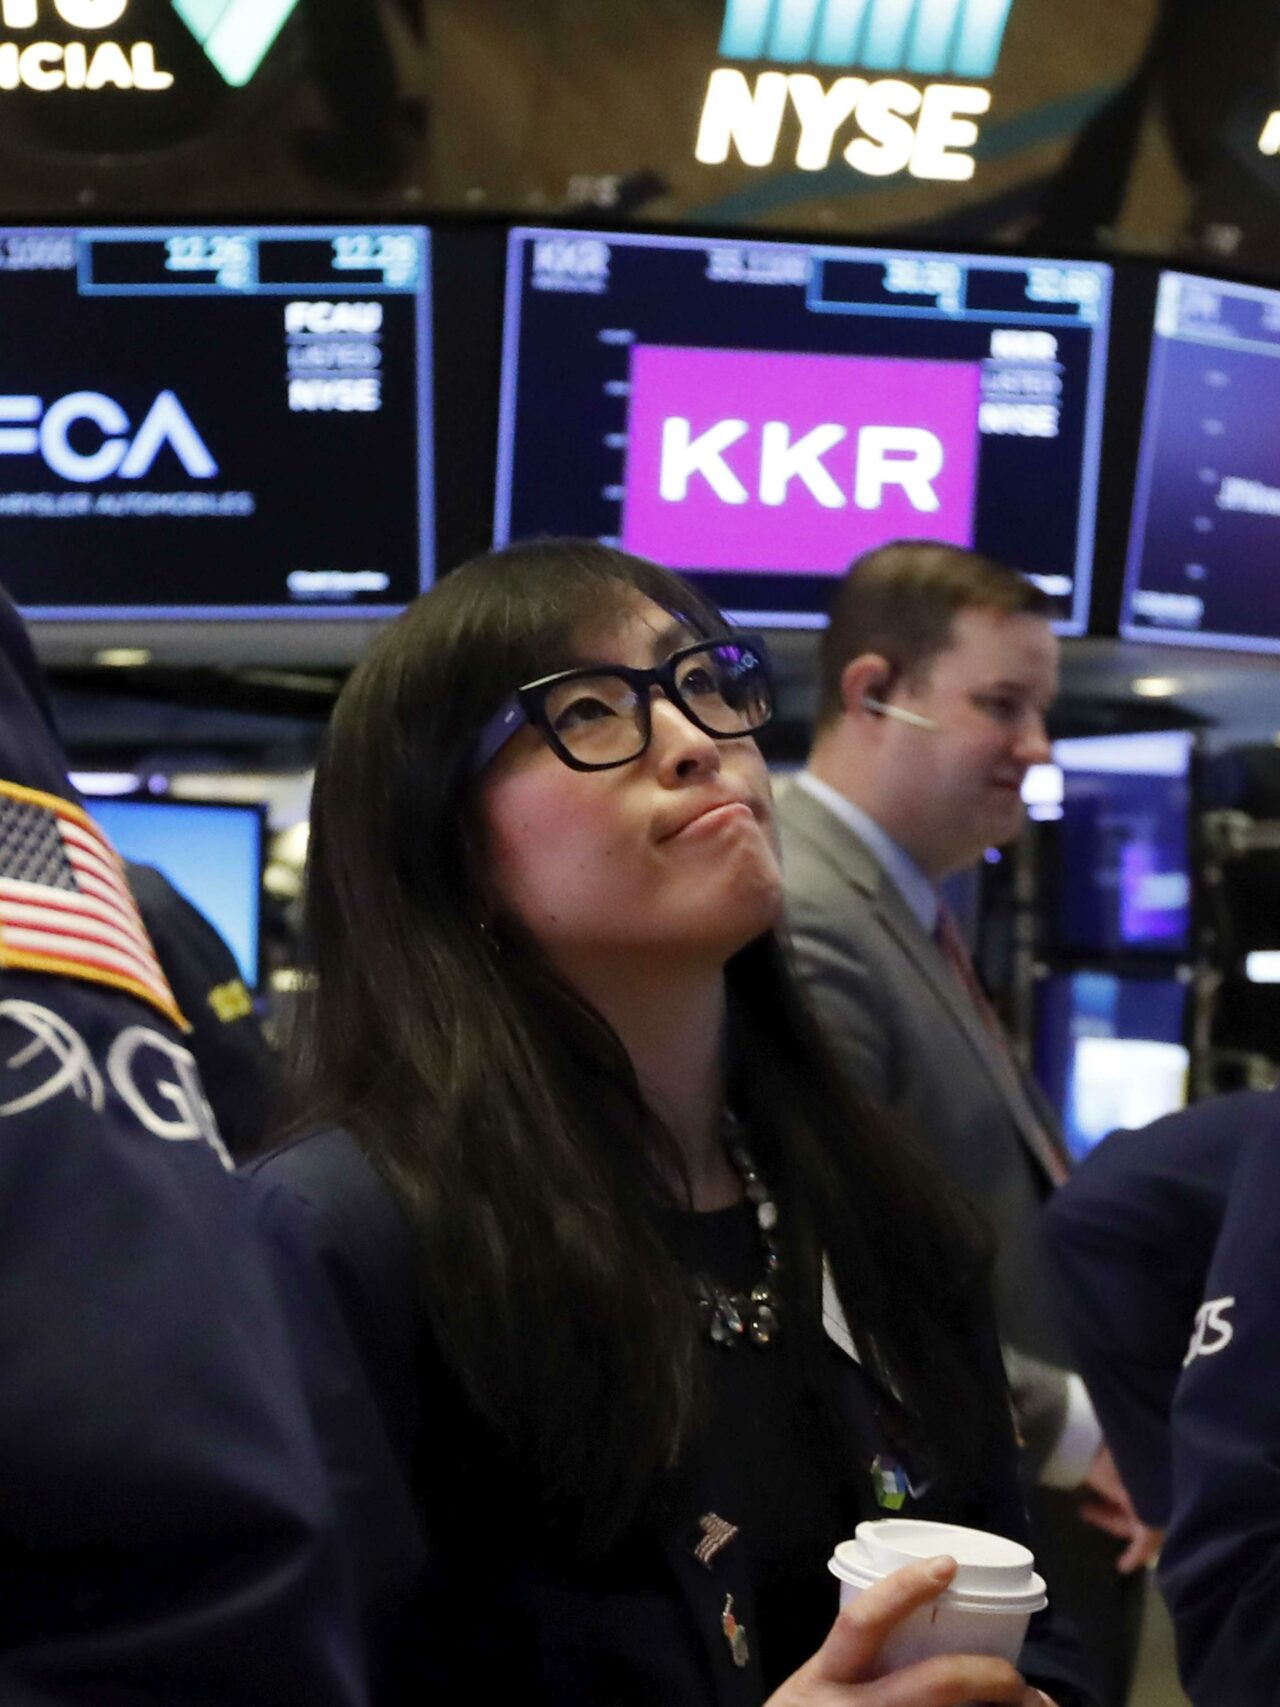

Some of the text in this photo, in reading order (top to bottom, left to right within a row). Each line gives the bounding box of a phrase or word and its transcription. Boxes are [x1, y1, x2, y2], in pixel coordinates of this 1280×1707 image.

[695, 68, 992, 182] NYSE
[0, 389, 219, 483] FCA
[287, 378, 383, 412] NYSE
[659, 415, 945, 512] KKR
